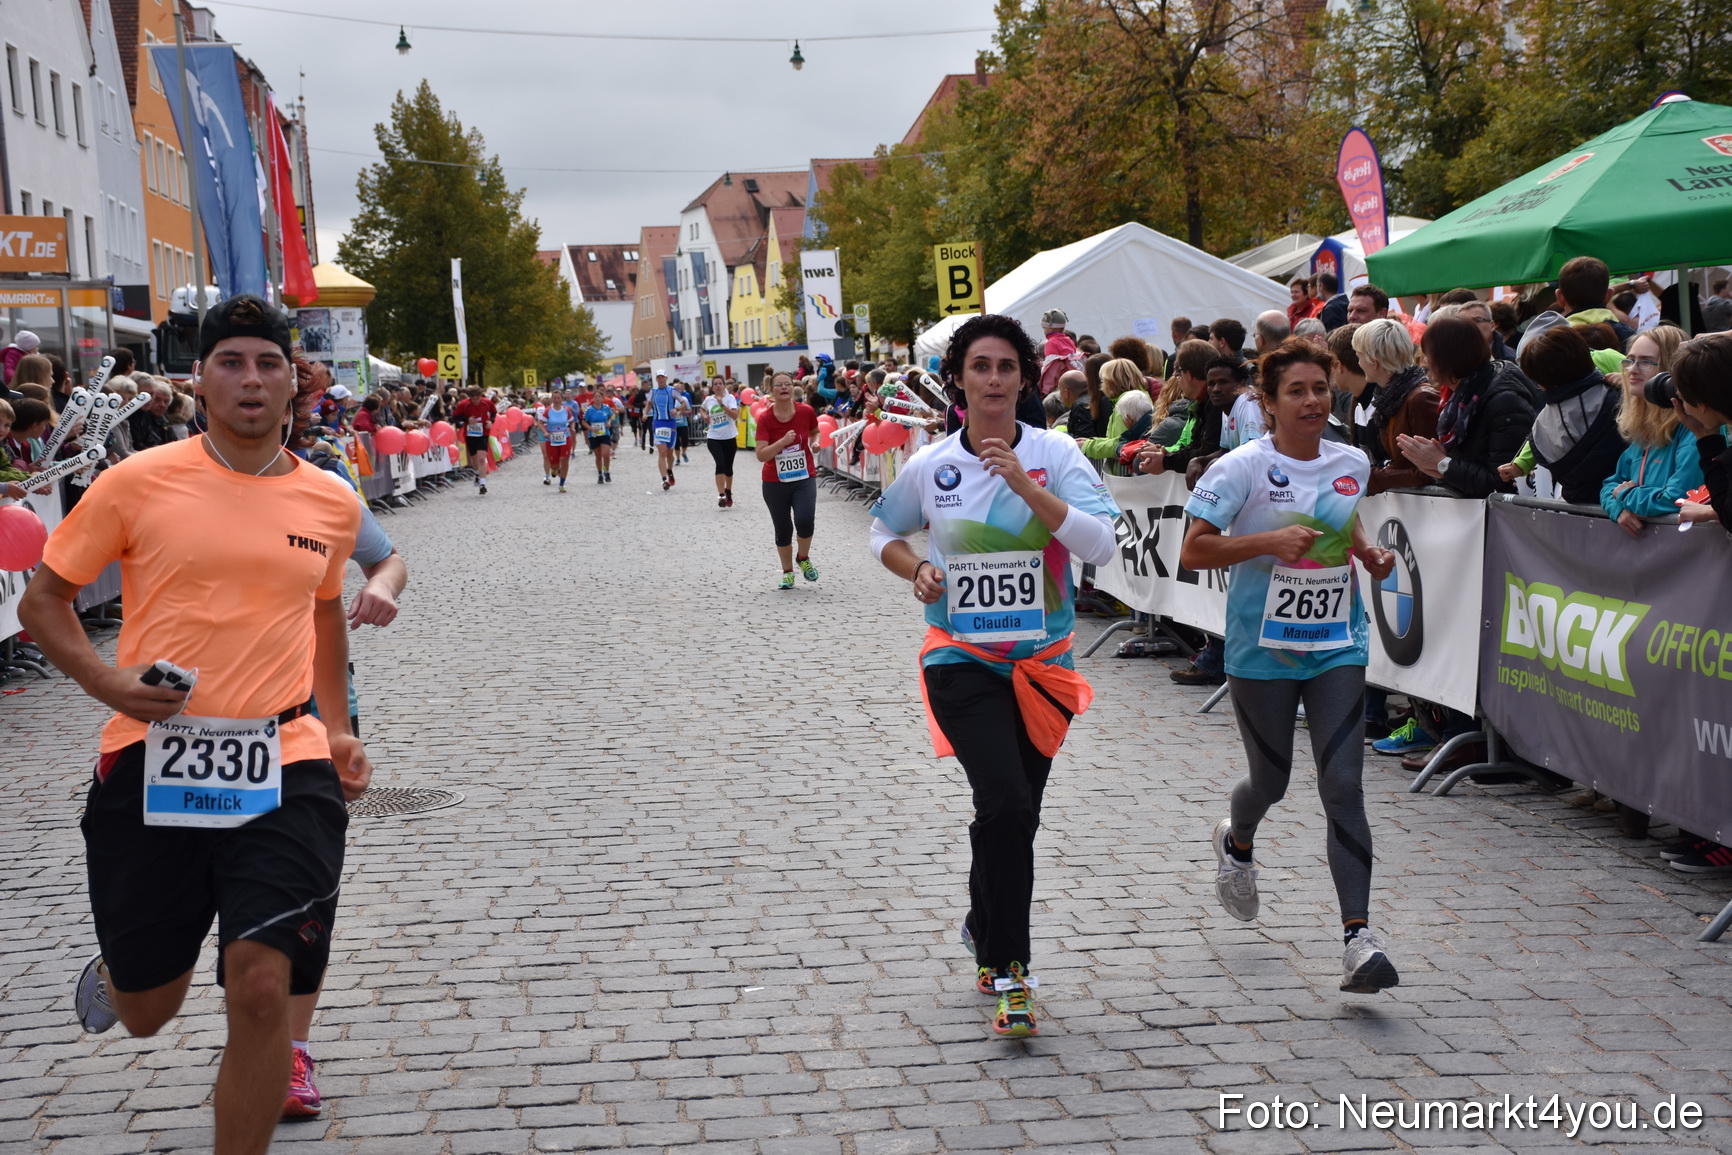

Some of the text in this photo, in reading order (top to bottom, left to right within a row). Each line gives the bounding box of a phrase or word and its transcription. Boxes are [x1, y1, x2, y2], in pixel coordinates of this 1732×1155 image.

[940, 245, 976, 260] Block
[948, 265, 973, 300] B
[444, 355, 456, 371] C
[707, 366, 714, 375] D
[527, 374, 535, 384] D
[87, 412, 100, 438] BMW
[99, 412, 113, 435] BMW
[780, 458, 805, 472] 2039
[935, 495, 962, 503] PARTL
[1269, 490, 1295, 498] PARTL
[936, 501, 963, 509] Neumarkt
[949, 560, 1027, 572] PARTL Neumarkt
[1273, 573, 1340, 586] PARTL Neumarkt
[957, 572, 1036, 608] 2059
[1275, 587, 1344, 620] 2637
[973, 615, 1021, 630] Claudia
[1282, 626, 1330, 640] Manuela
[1505, 583, 1639, 683] BOCK
[1497, 659, 1547, 695] inspired
[1555, 684, 1584, 714] smart
[1585, 697, 1641, 734] concepts
[152, 721, 260, 738] PARTL Neumarkt
[160, 735, 271, 784] 2330
[183, 791, 243, 811] Patrick
